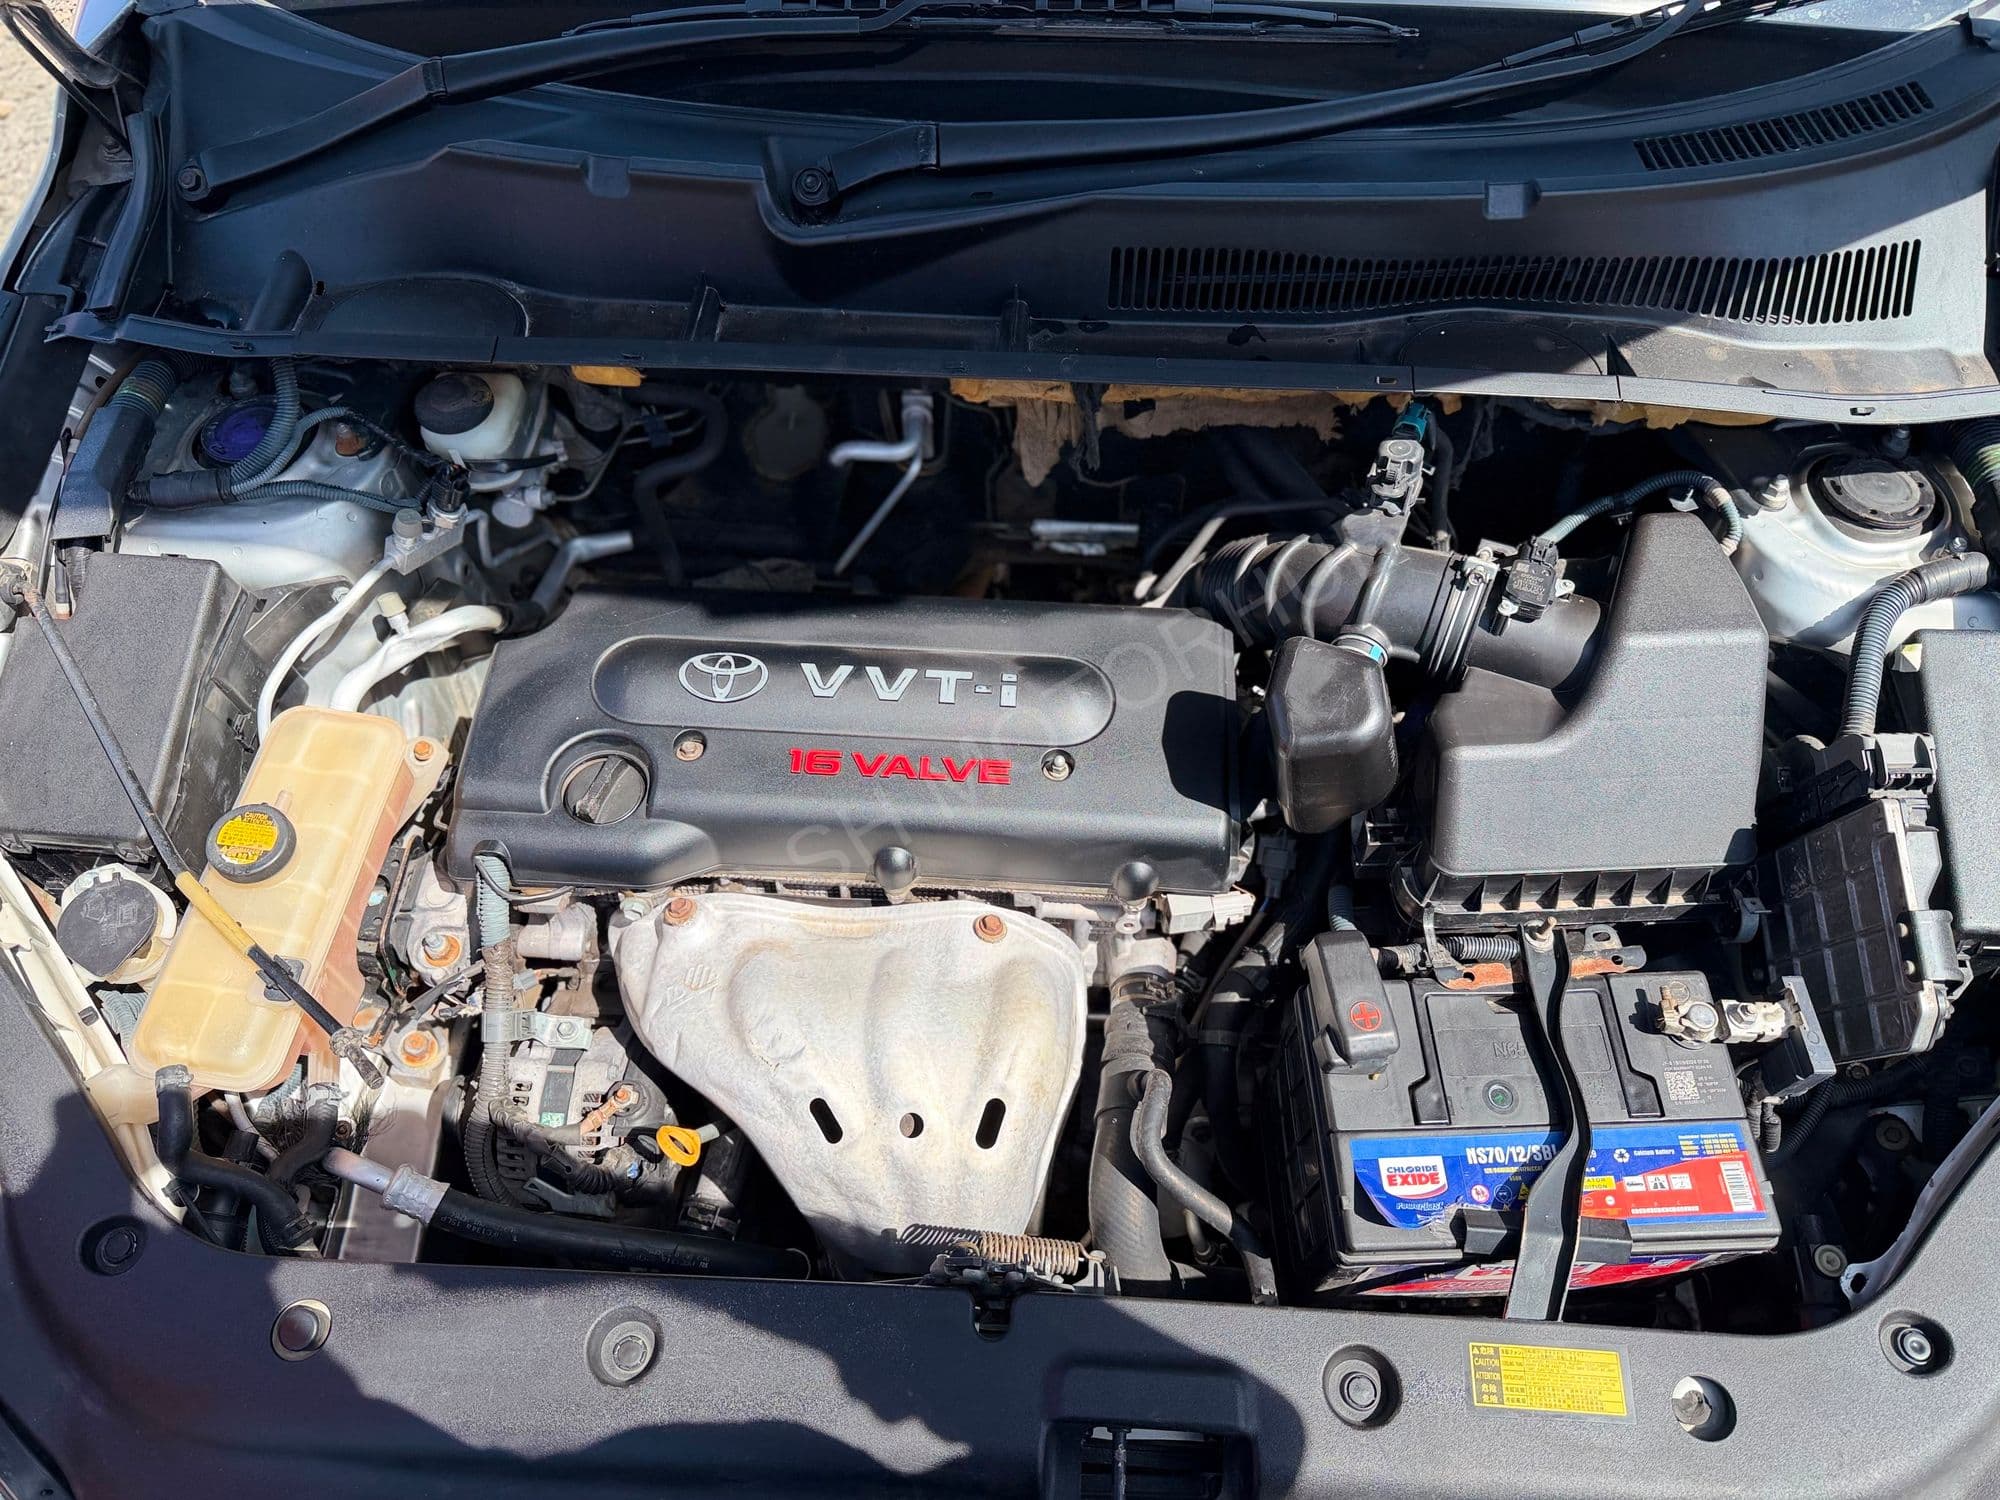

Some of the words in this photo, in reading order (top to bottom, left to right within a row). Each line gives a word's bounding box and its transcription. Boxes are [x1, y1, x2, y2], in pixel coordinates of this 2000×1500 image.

[800, 662, 1018, 707] VVT-i
[789, 748, 843, 776] 16
[851, 752, 1012, 785] VALVE
[1387, 1165, 1438, 1174] CHLORIDE
[1386, 1172, 1440, 1187] EXIDE
[1475, 1358, 1499, 1367] CAUTION
